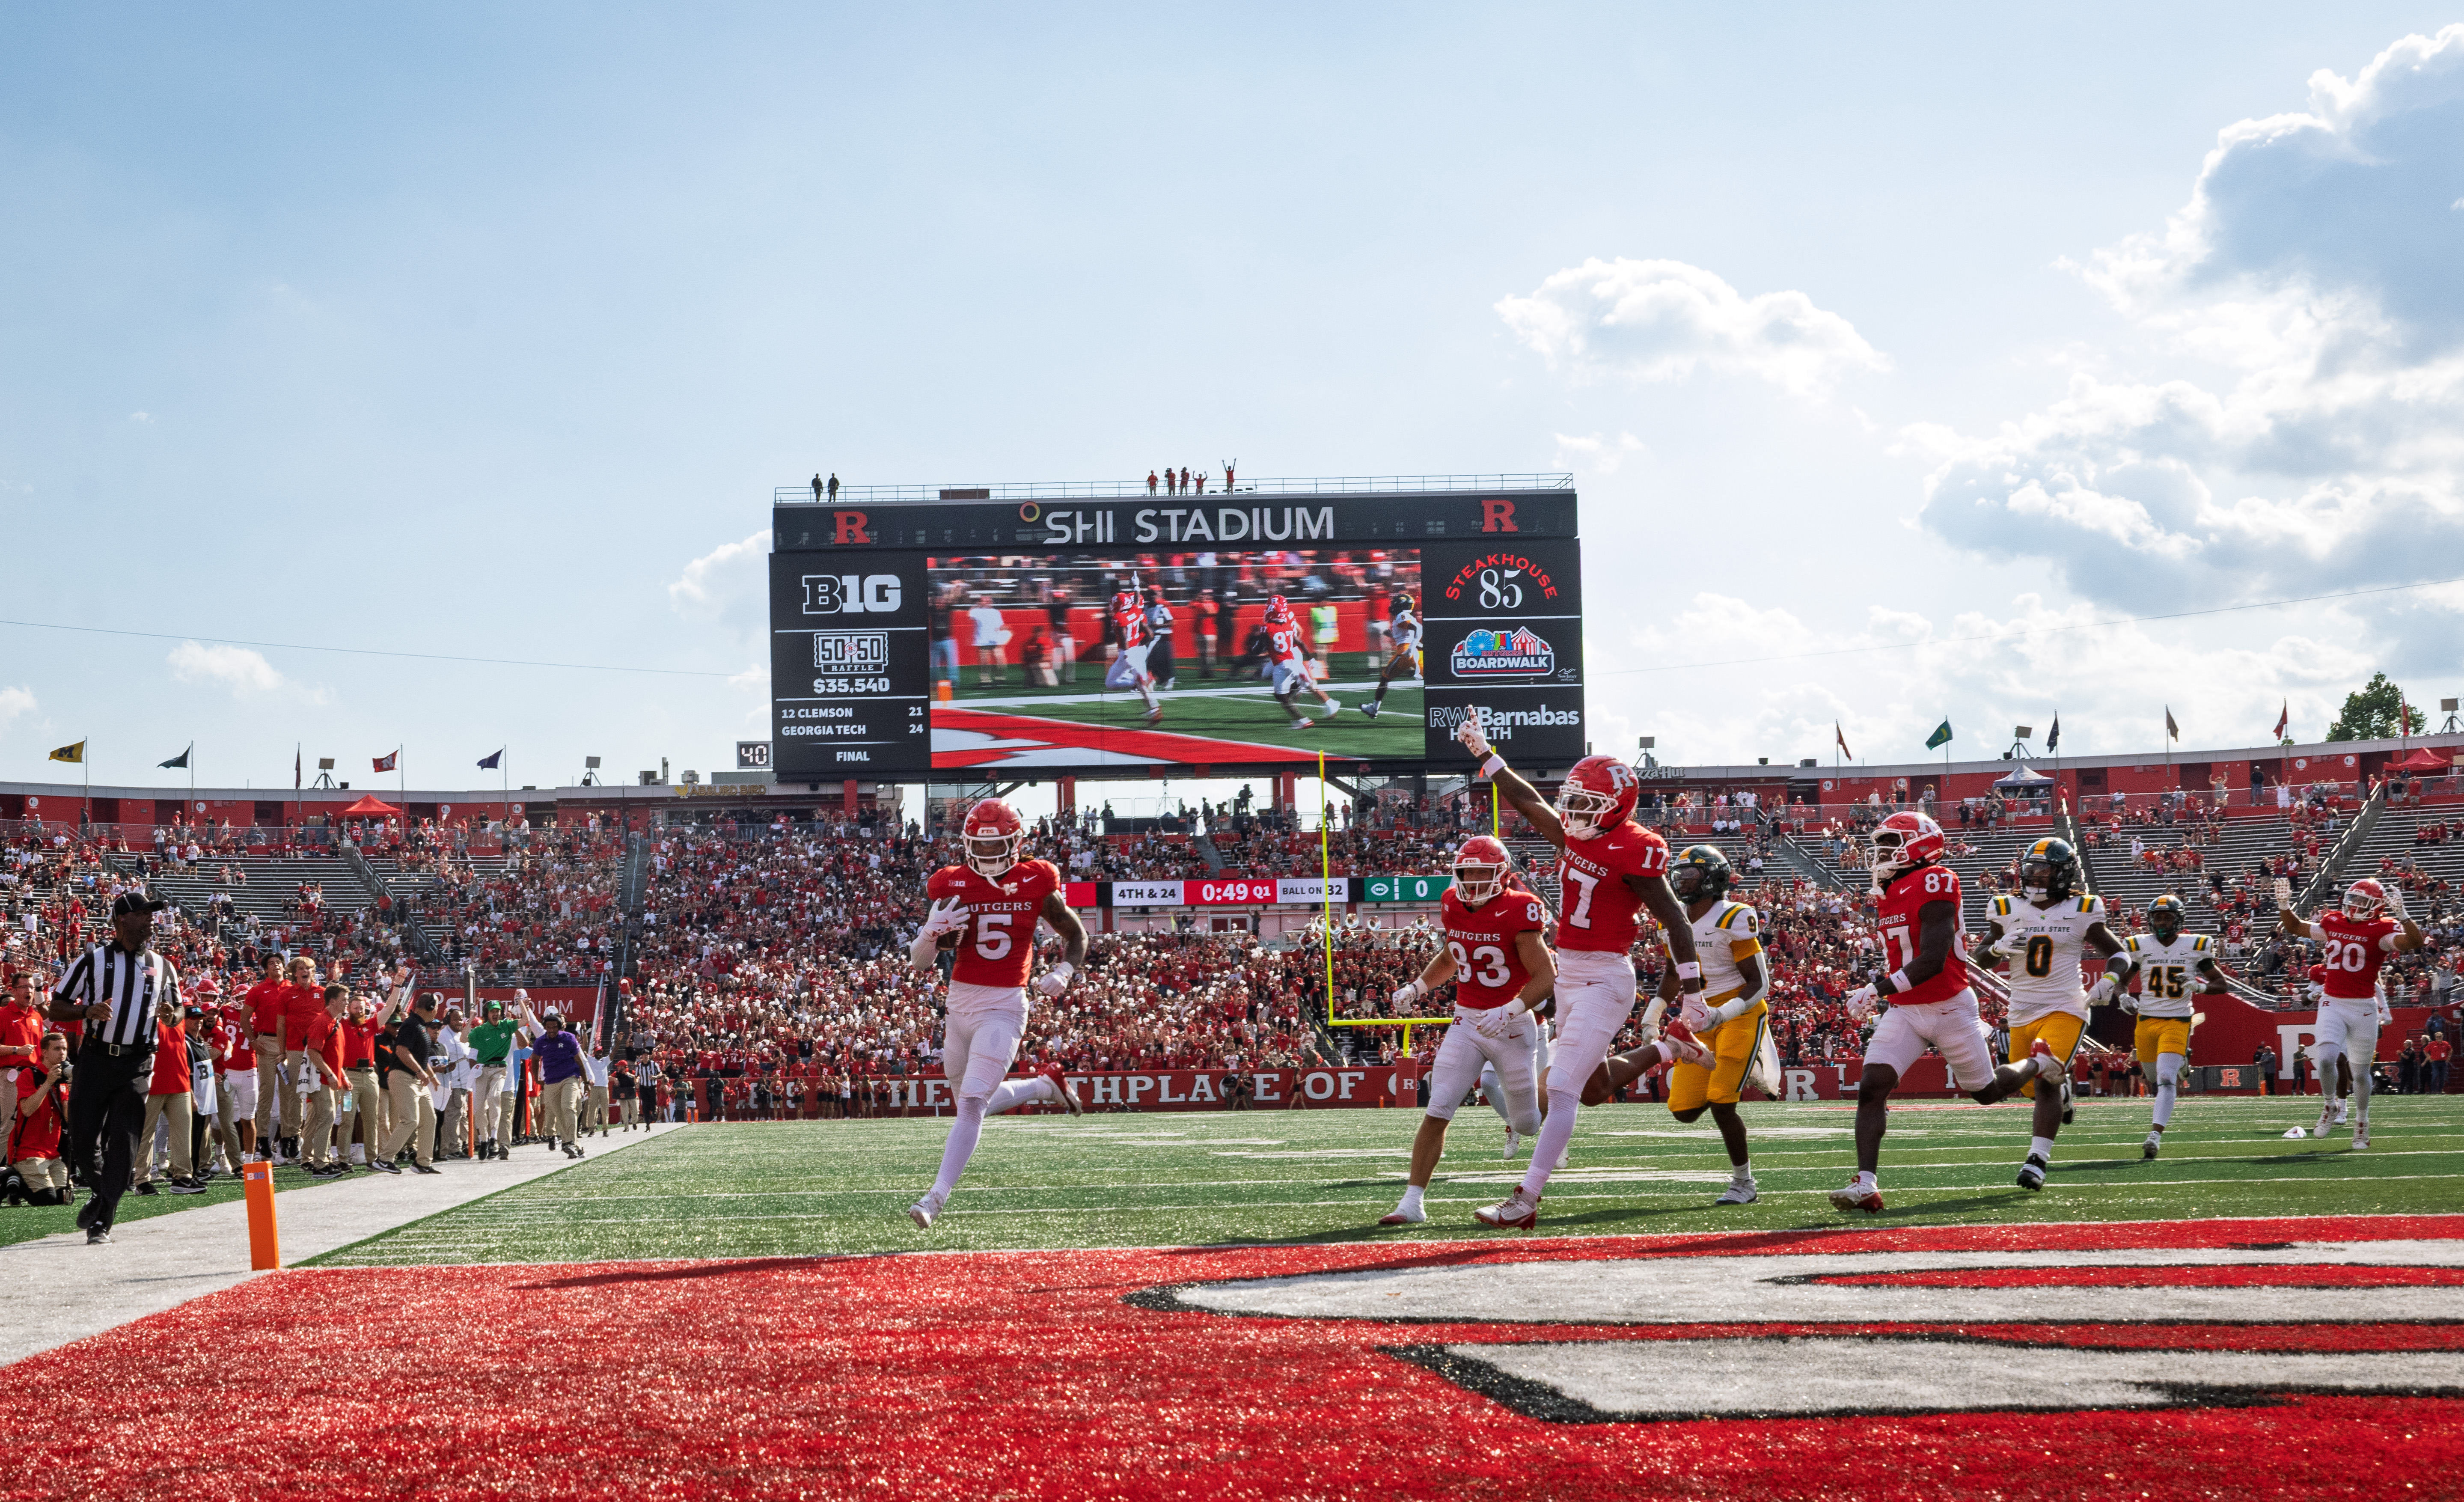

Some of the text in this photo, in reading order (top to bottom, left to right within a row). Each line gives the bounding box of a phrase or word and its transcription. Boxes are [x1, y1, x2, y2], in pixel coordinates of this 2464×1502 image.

[1043, 506, 1334, 544] SHI STADIUM
[1481, 500, 1519, 532] R
[833, 511, 870, 544] R
[1446, 553, 1558, 600] STEAKHOUSE
[1480, 569, 1522, 609] 85
[821, 638, 881, 661] 50 50
[1456, 656, 1548, 669] BOARDWALK
[813, 678, 890, 694] $35,540
[782, 708, 853, 719] 12 CLEMSON
[909, 706, 923, 716] 21
[782, 725, 866, 736] GEORGIA TECH
[909, 724, 924, 734] 24
[1450, 727, 1512, 741] HLTH
[58, 747, 74, 758] M
[741, 745, 767, 765] 40
[836, 751, 870, 761] FINAL
[1606, 765, 1633, 789] R
[1659, 766, 1685, 779] Hut
[690, 785, 767, 796] ABSURD BIRD
[1564, 845, 1608, 876] UTGERS
[1642, 846, 1667, 870] 17
[1202, 883, 1271, 901] 0:49 Q1
[1282, 885, 1343, 895] BALL ON 32
[1415, 880, 1428, 898] 0
[1925, 873, 1953, 893] 87
[1119, 888, 1176, 899] 4TH & 24
[966, 901, 1032, 913] UTGERS
[1526, 902, 1545, 922] 83
[1879, 913, 1906, 926] TGERS
[975, 913, 1012, 961] 5
[1448, 929, 1500, 941] RUTGERS
[1448, 941, 1511, 987] 83
[2026, 934, 2054, 978] 0
[2325, 940, 2366, 972] 20
[2149, 966, 2185, 999] 45
[1366, 989, 1377, 999] R
[1452, 1016, 1463, 1026] R
[1304, 1072, 1364, 1100] OF
[1403, 1079, 1415, 1089] R
[1785, 1070, 1819, 1101] R
[2220, 1069, 2241, 1087] R
